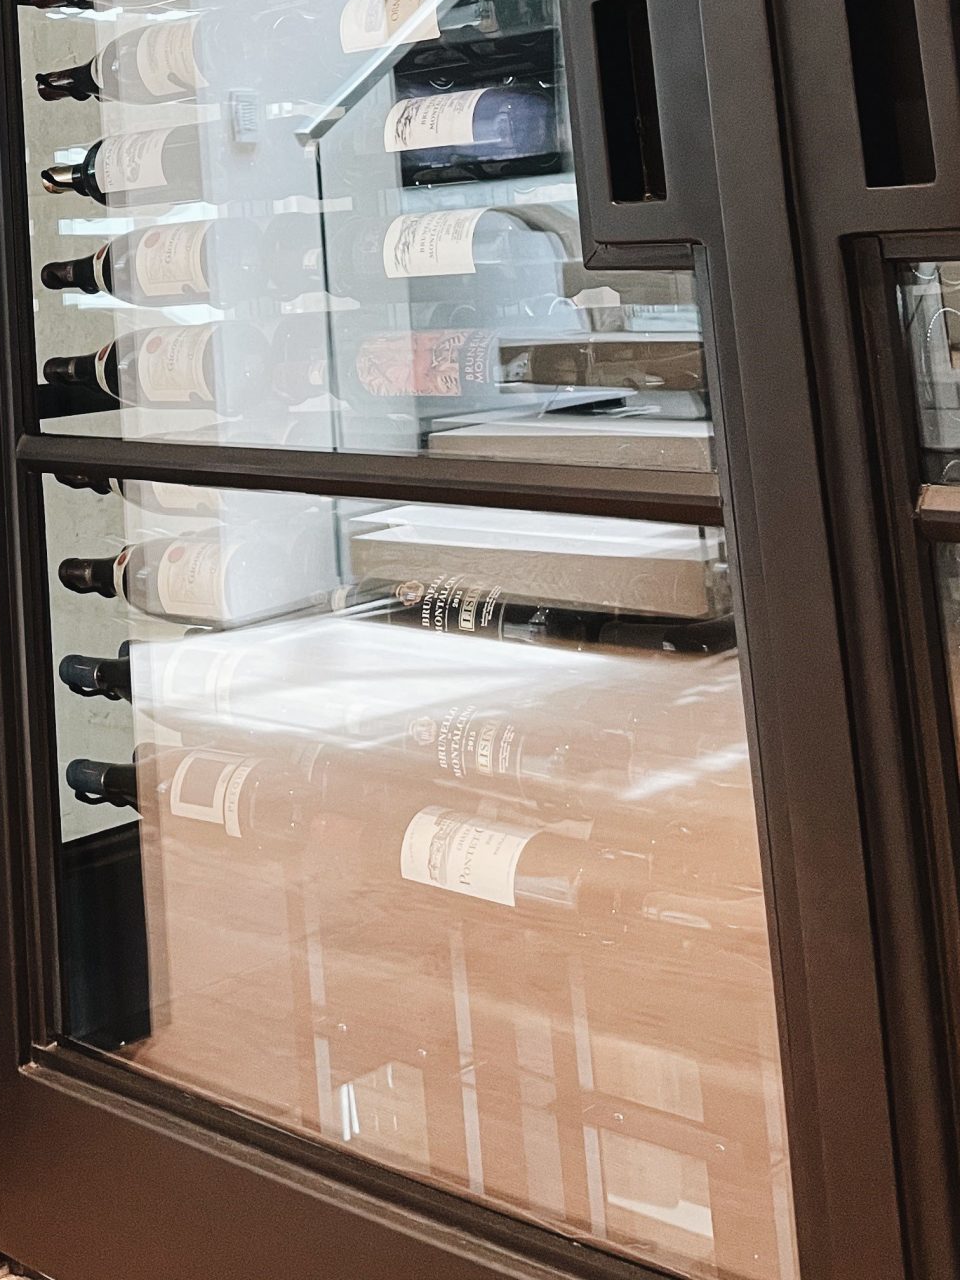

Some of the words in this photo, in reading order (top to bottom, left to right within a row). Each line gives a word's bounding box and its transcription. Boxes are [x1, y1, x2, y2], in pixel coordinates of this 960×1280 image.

[452, 590, 463, 609] 2015
[437, 706, 458, 769] BRUNELLO
[451, 705, 476, 779] MONTALCINO
[467, 731, 477, 752] 2015
[459, 834, 480, 886] PONTET
